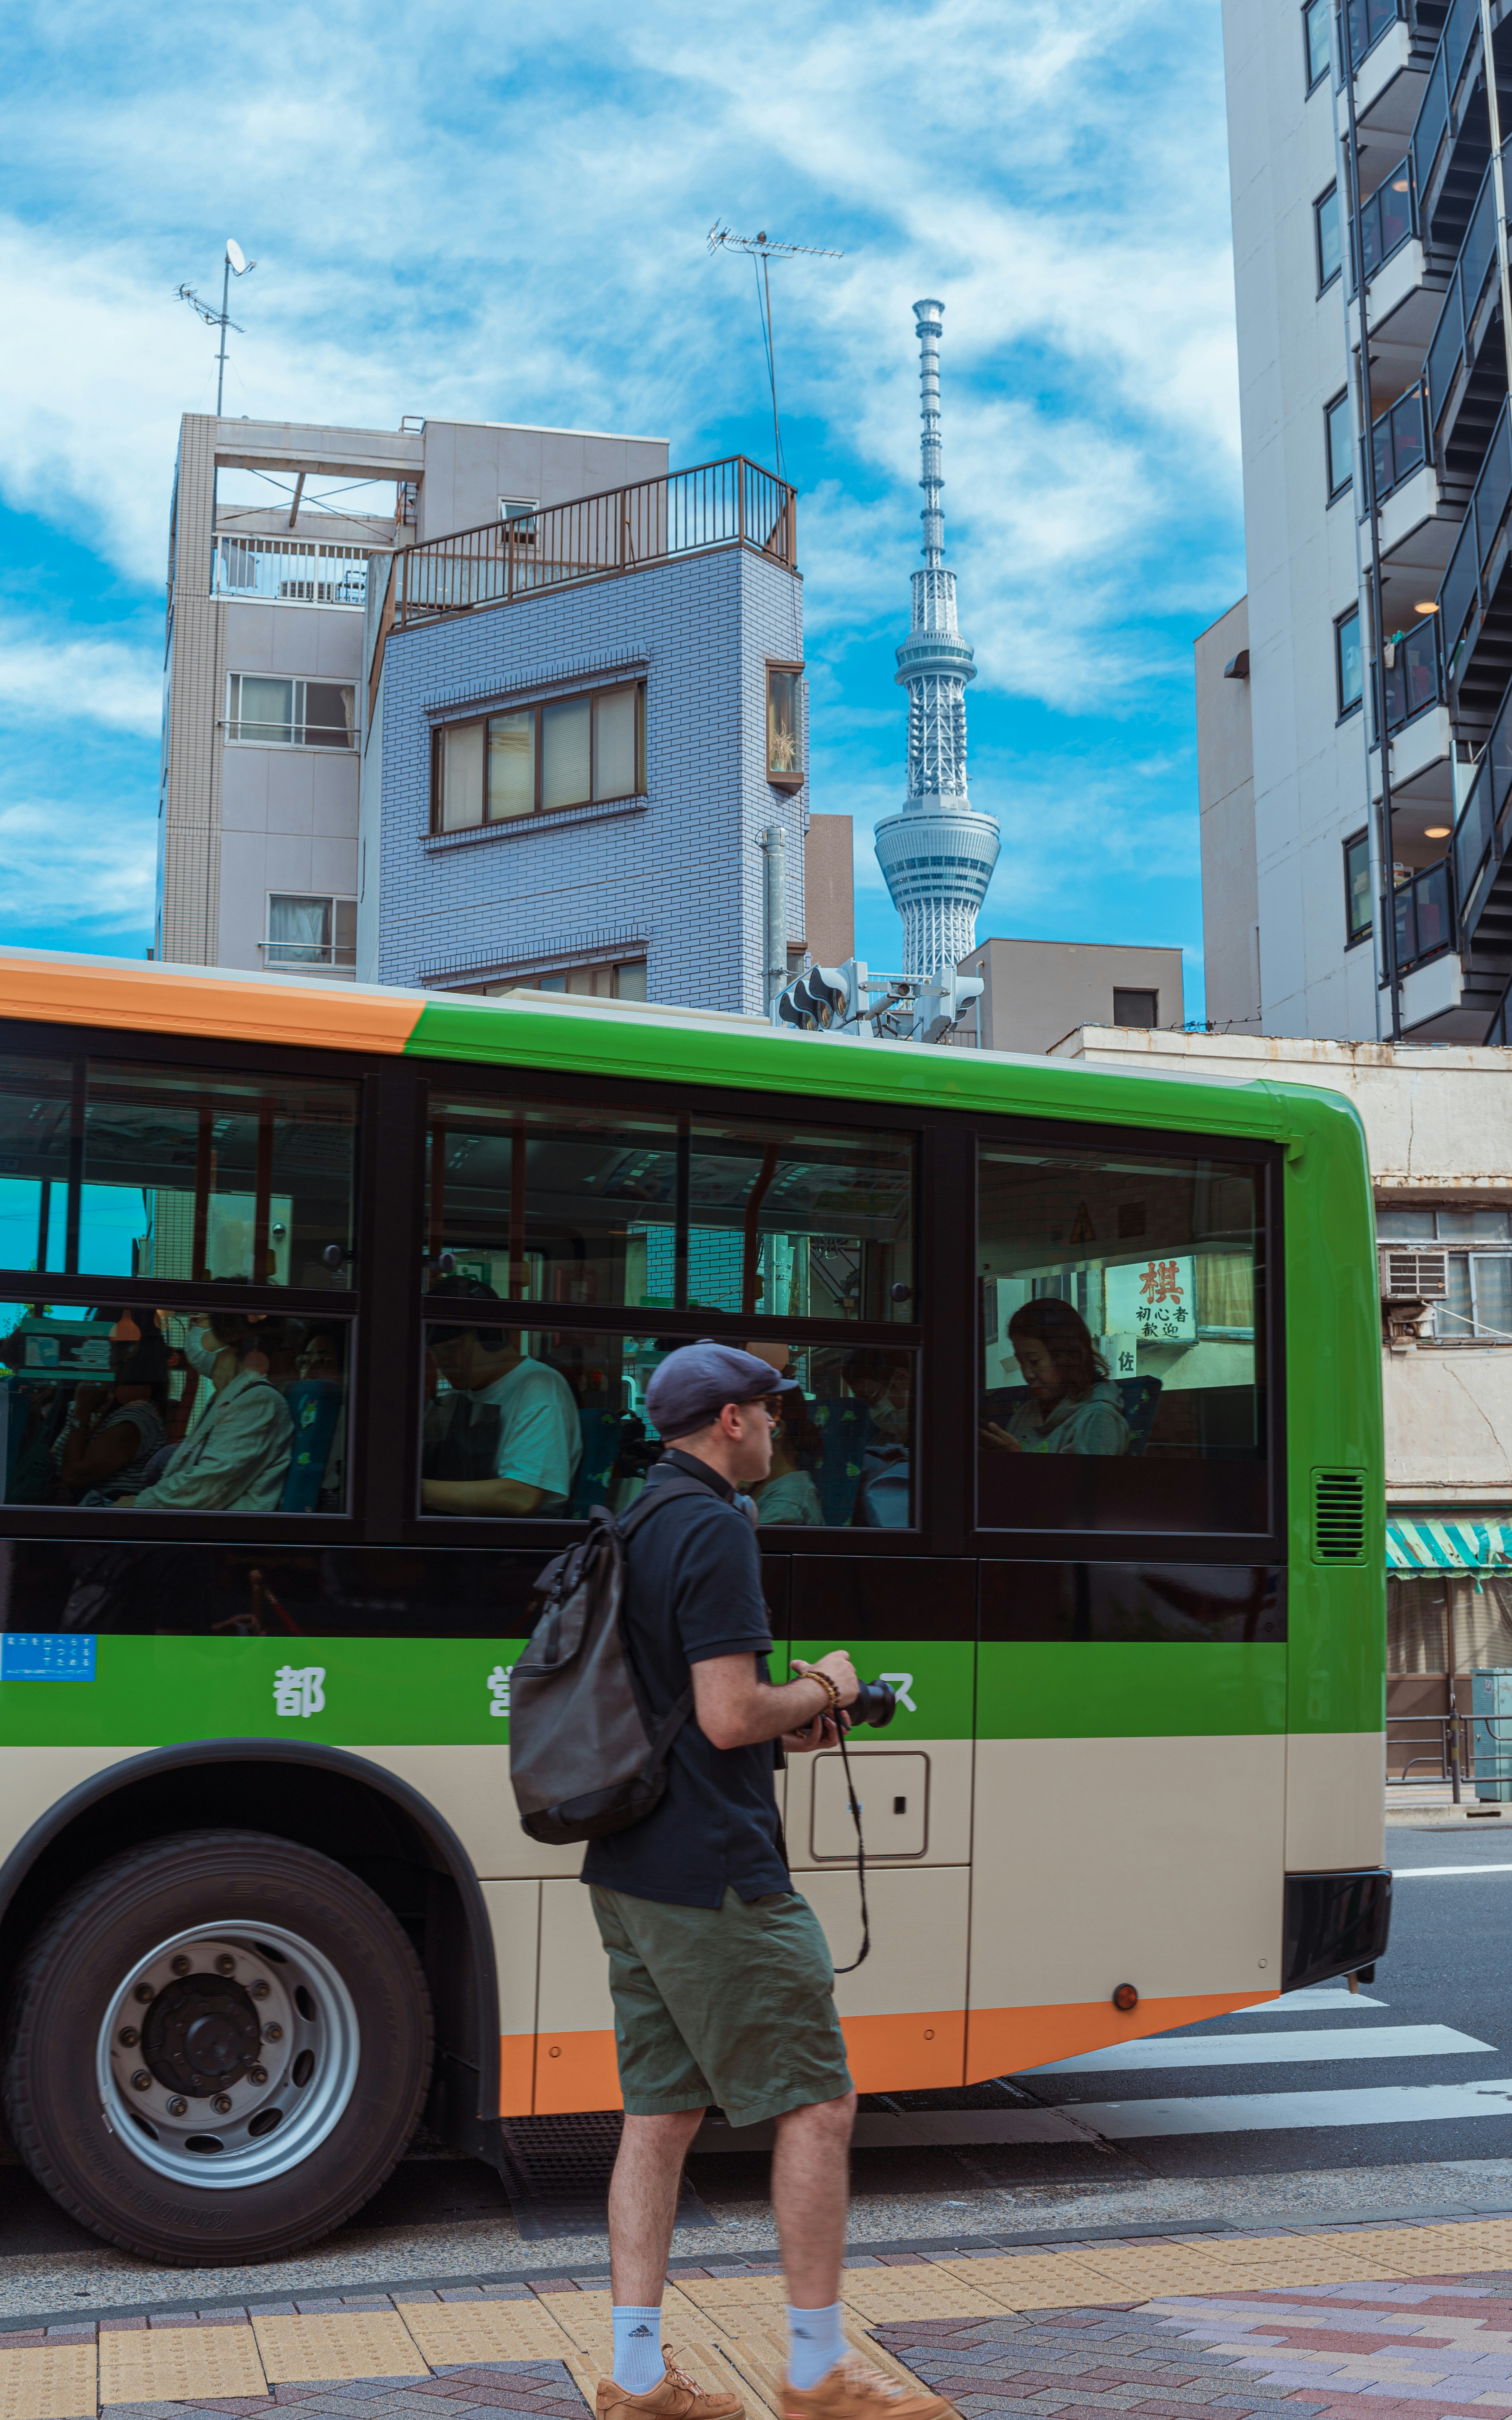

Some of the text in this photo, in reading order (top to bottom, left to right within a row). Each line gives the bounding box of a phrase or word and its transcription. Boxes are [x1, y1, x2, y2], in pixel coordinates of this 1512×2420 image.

[1139, 1260, 1184, 1304] 棋
[1136, 1306, 1189, 1323] 初心者
[1141, 1322, 1180, 1338] 歓迎
[1118, 1351, 1134, 1371] 佐
[272, 1665, 326, 1717] 都
